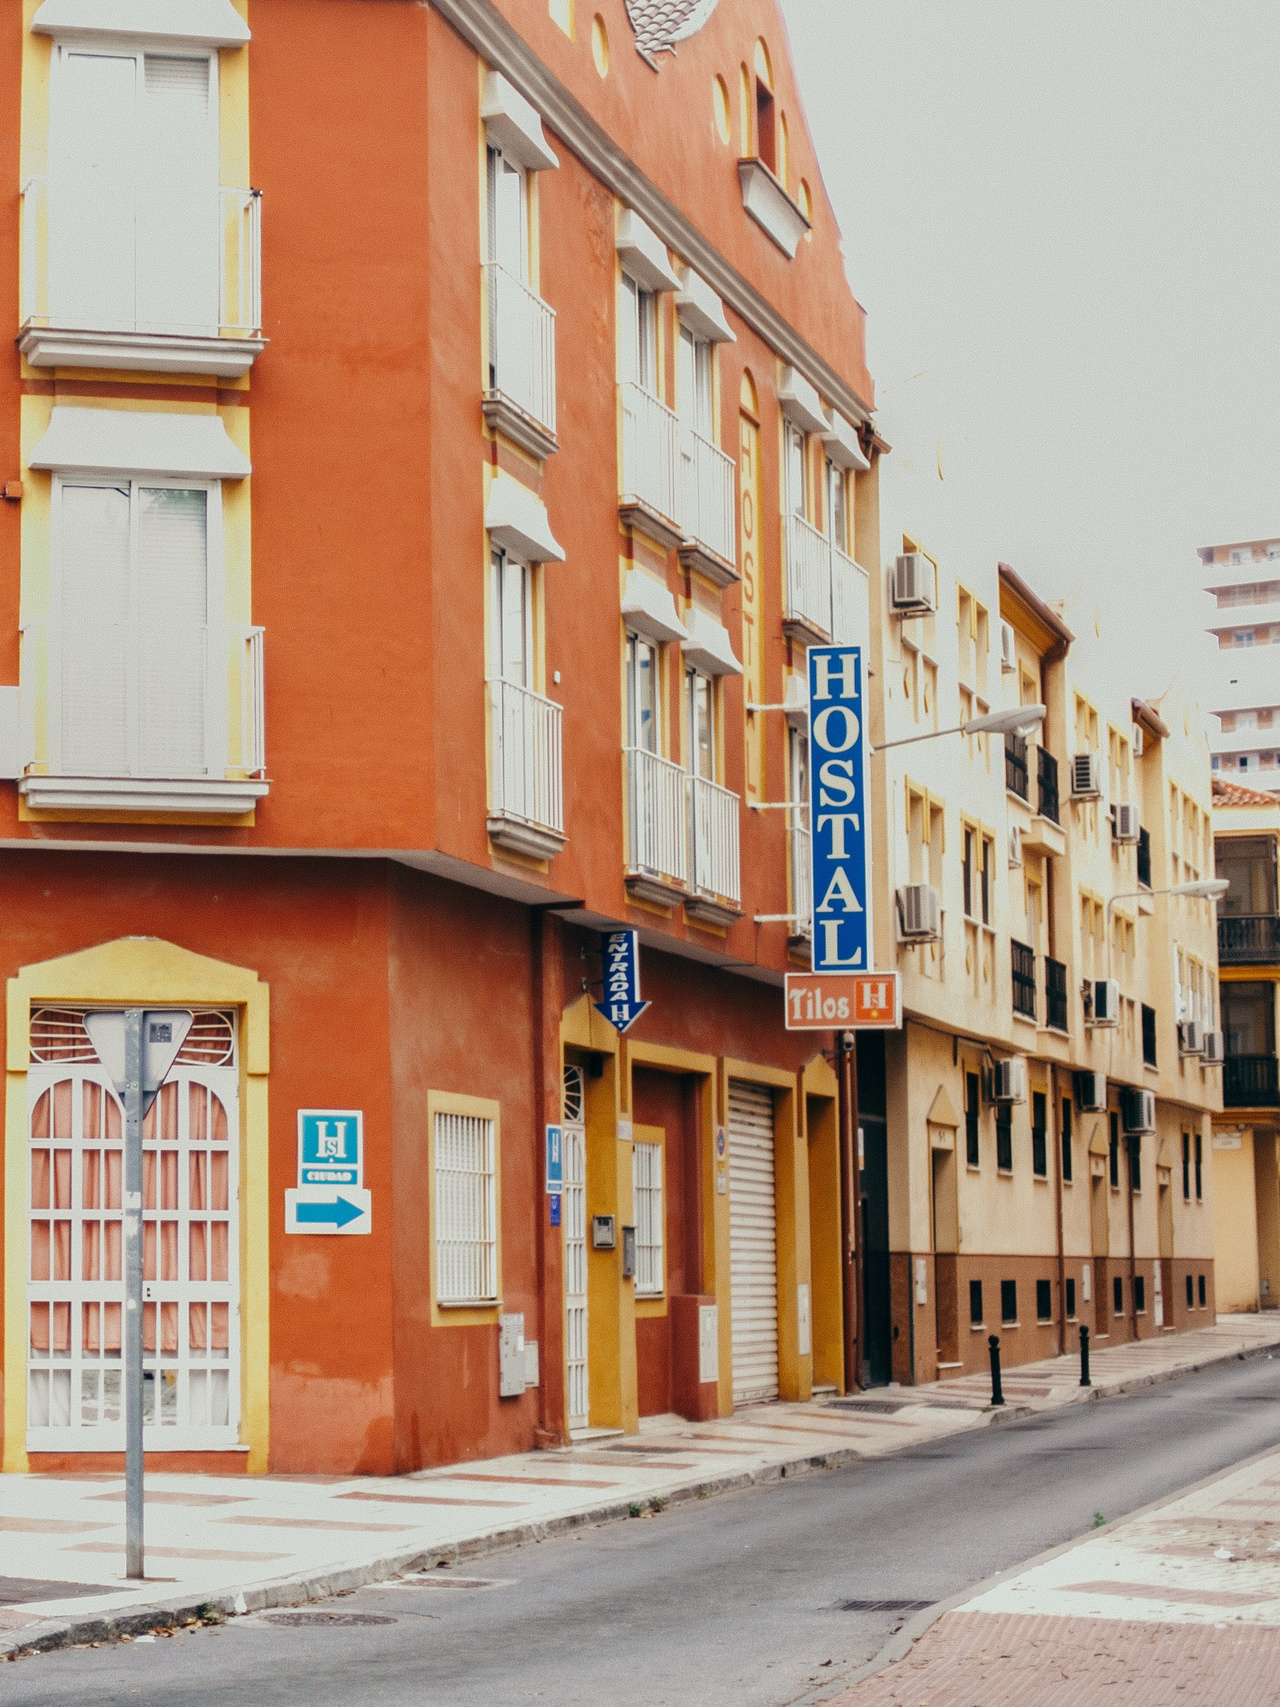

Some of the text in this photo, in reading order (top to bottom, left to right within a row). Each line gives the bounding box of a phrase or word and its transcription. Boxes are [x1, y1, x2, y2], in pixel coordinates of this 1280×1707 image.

[812, 653, 863, 967] HOSTAL
[608, 933, 629, 1001] ENTRADA
[789, 988, 850, 1019] Tilos
[306, 1171, 352, 1181] CIUDAD
